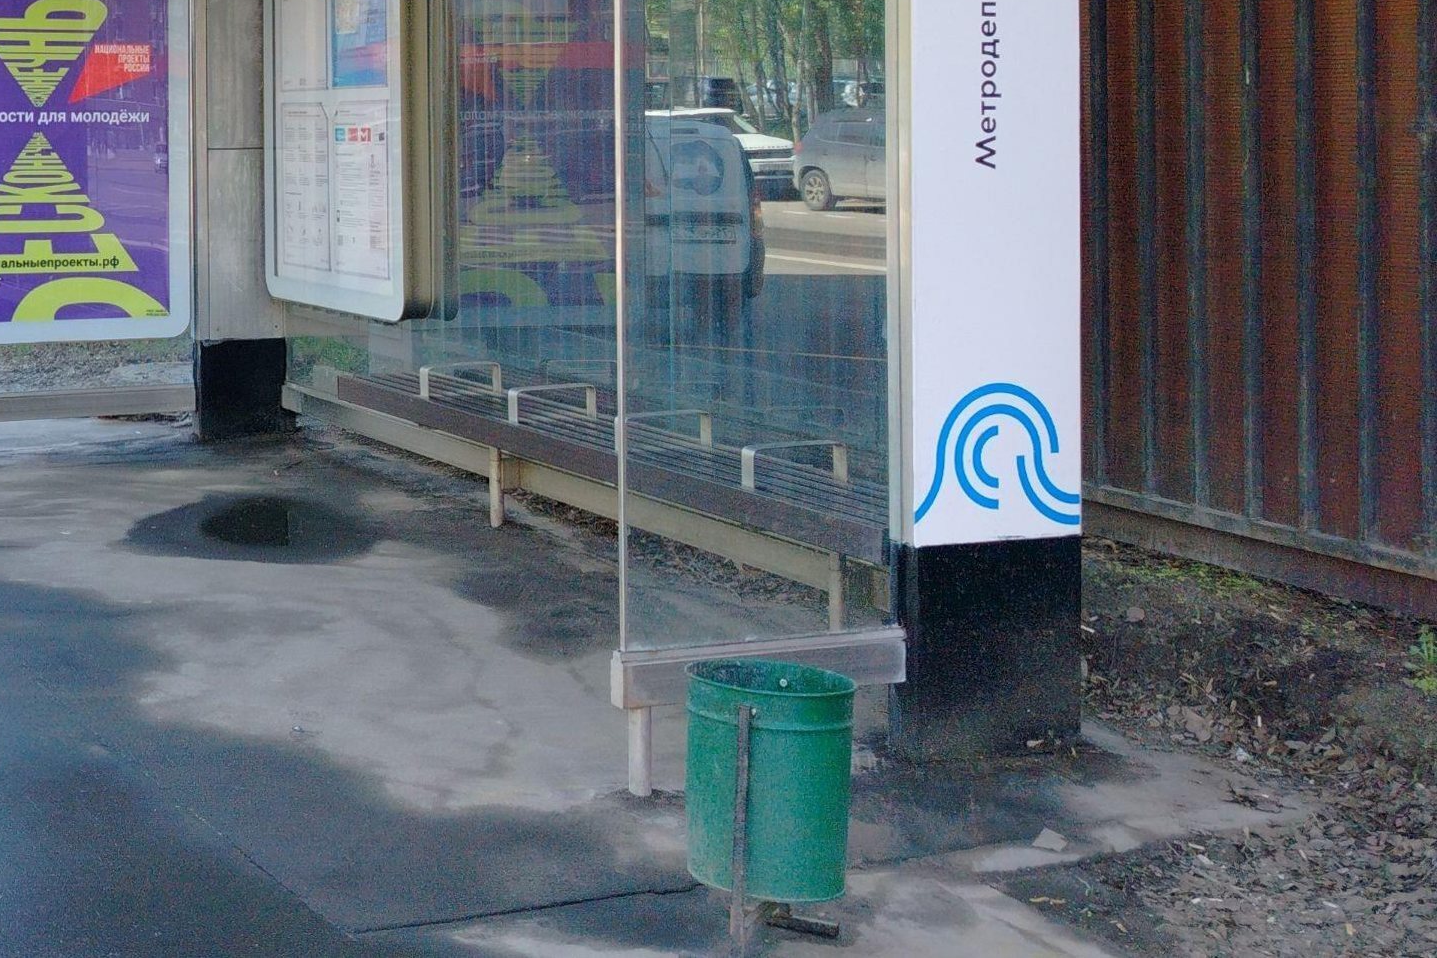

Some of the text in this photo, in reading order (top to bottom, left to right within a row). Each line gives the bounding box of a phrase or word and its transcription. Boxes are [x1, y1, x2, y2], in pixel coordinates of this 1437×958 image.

[117, 54, 150, 63] ПРОЕКТЫ
[124, 63, 150, 72] РОССИИ
[38, 111, 66, 125] для
[71, 109, 150, 124] молодёжи
